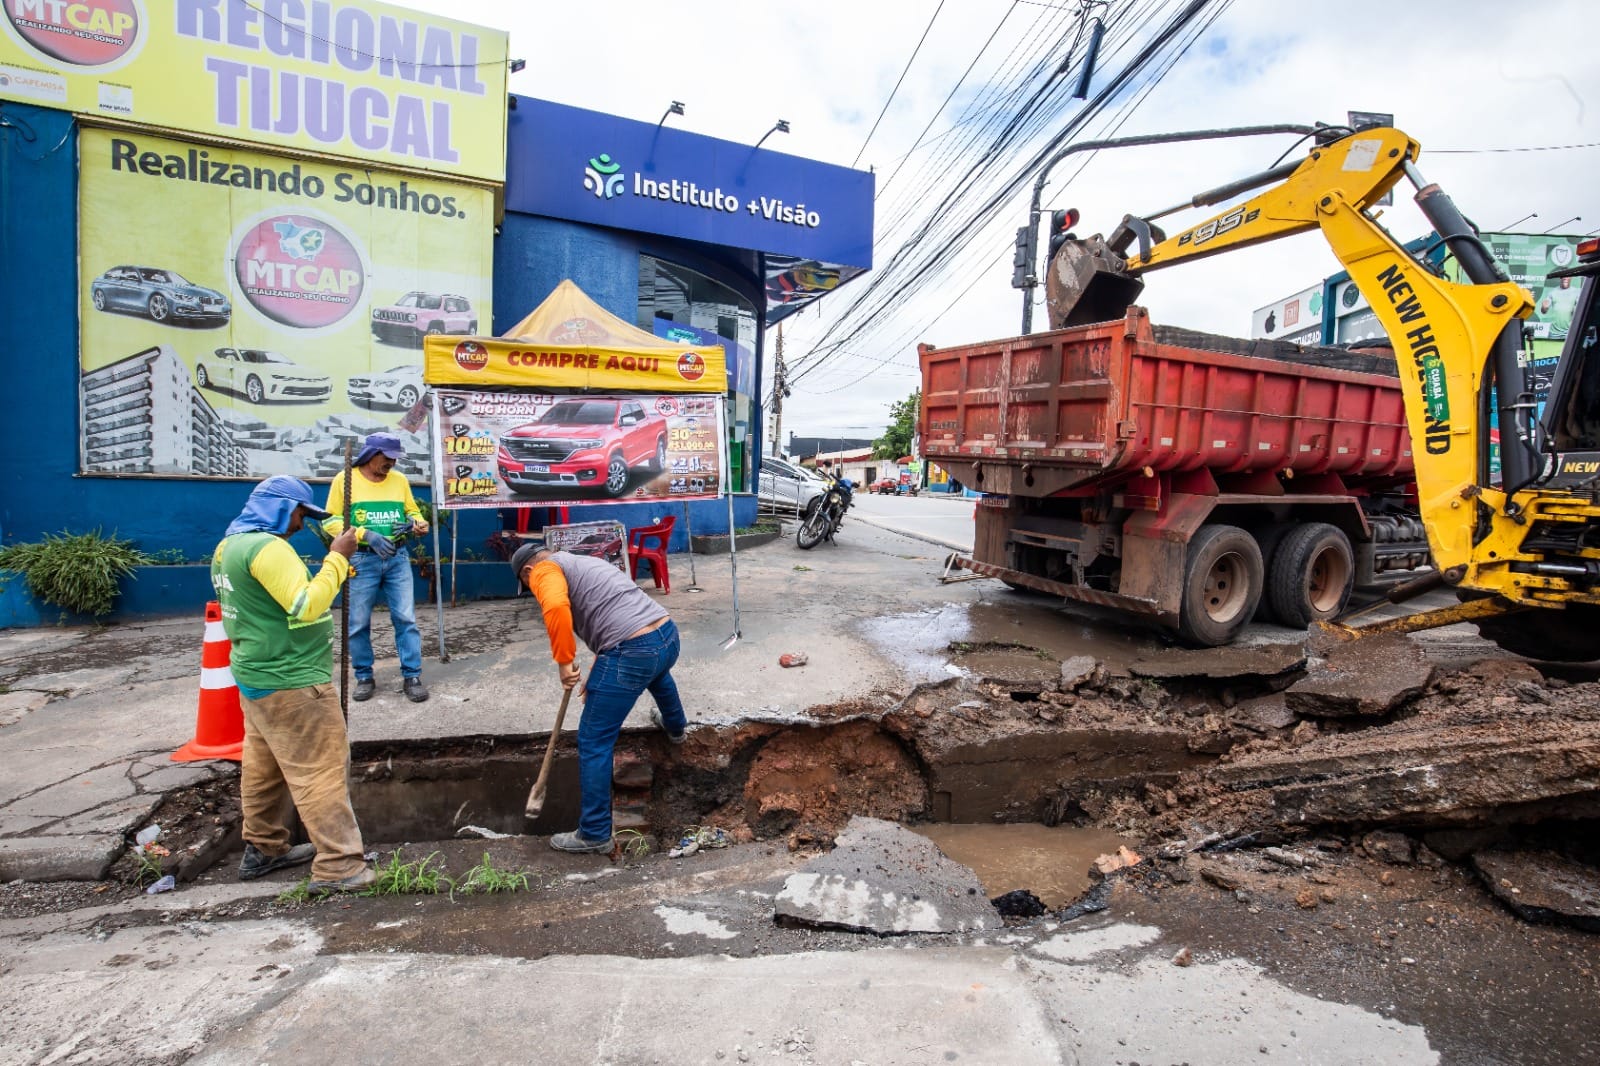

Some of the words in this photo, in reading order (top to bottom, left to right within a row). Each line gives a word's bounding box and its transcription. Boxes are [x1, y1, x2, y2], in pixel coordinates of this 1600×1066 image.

[14, 0, 134, 36] MTCAP
[15, 18, 72, 36] REALIZANDO
[74, 30, 92, 39] SEU
[94, 34, 124, 46] SONHO
[176, 0, 486, 96] REGIONAL
[205, 56, 460, 163] TIJUCAL
[111, 138, 325, 199] Realizando
[333, 172, 466, 220] Sonhos.
[633, 172, 739, 213] Instituto
[747, 197, 821, 228] +Visão
[247, 259, 360, 295] MTCAP
[247, 287, 301, 299] REALIZANDO
[303, 293, 320, 301] SEU
[321, 295, 351, 304] SONHO
[1376, 264, 1426, 324] NEW
[457, 352, 487, 361] MTCAP
[507, 350, 600, 369] COMPRE
[605, 355, 660, 373] AQUI
[1431, 368, 1444, 399] CUIABÁ
[471, 392, 554, 406] RAMPAGE
[471, 404, 495, 415] BIG
[497, 403, 536, 415] HORN
[444, 436, 471, 455] 10
[472, 438, 493, 446] MIL
[1563, 461, 1600, 473] NEW
[447, 478, 474, 496] 10
[366, 509, 401, 520] CUIABÁ
